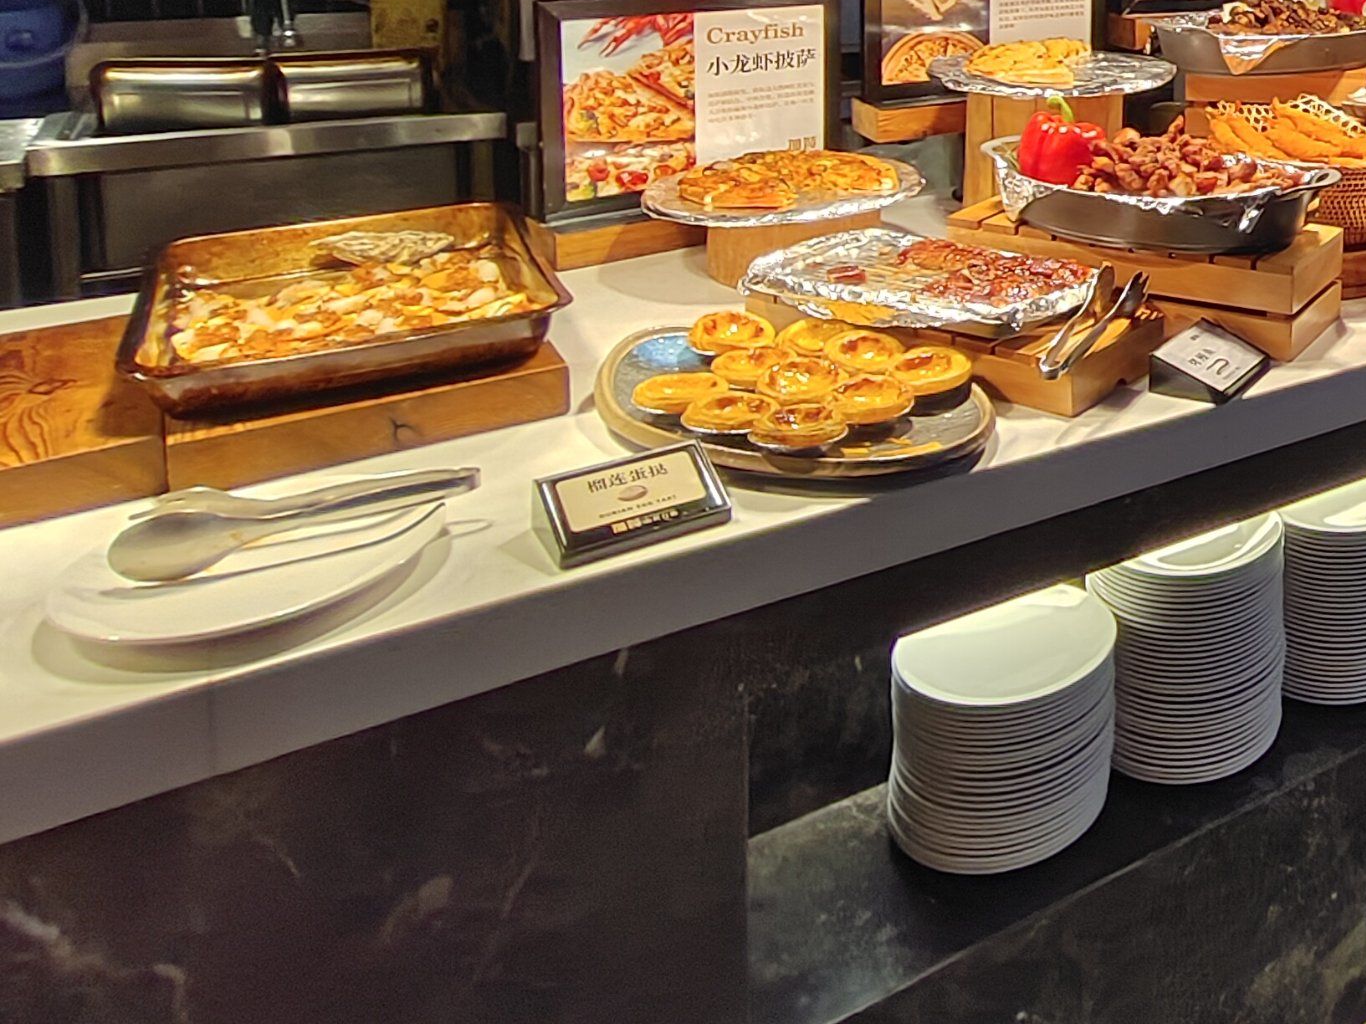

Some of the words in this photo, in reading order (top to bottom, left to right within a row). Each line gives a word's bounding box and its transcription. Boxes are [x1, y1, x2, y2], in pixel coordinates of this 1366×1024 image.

[706, 22, 804, 44] Crayfish
[706, 48, 816, 76] 小龙虾披萨
[587, 463, 668, 494] 榴莲蛋挞
